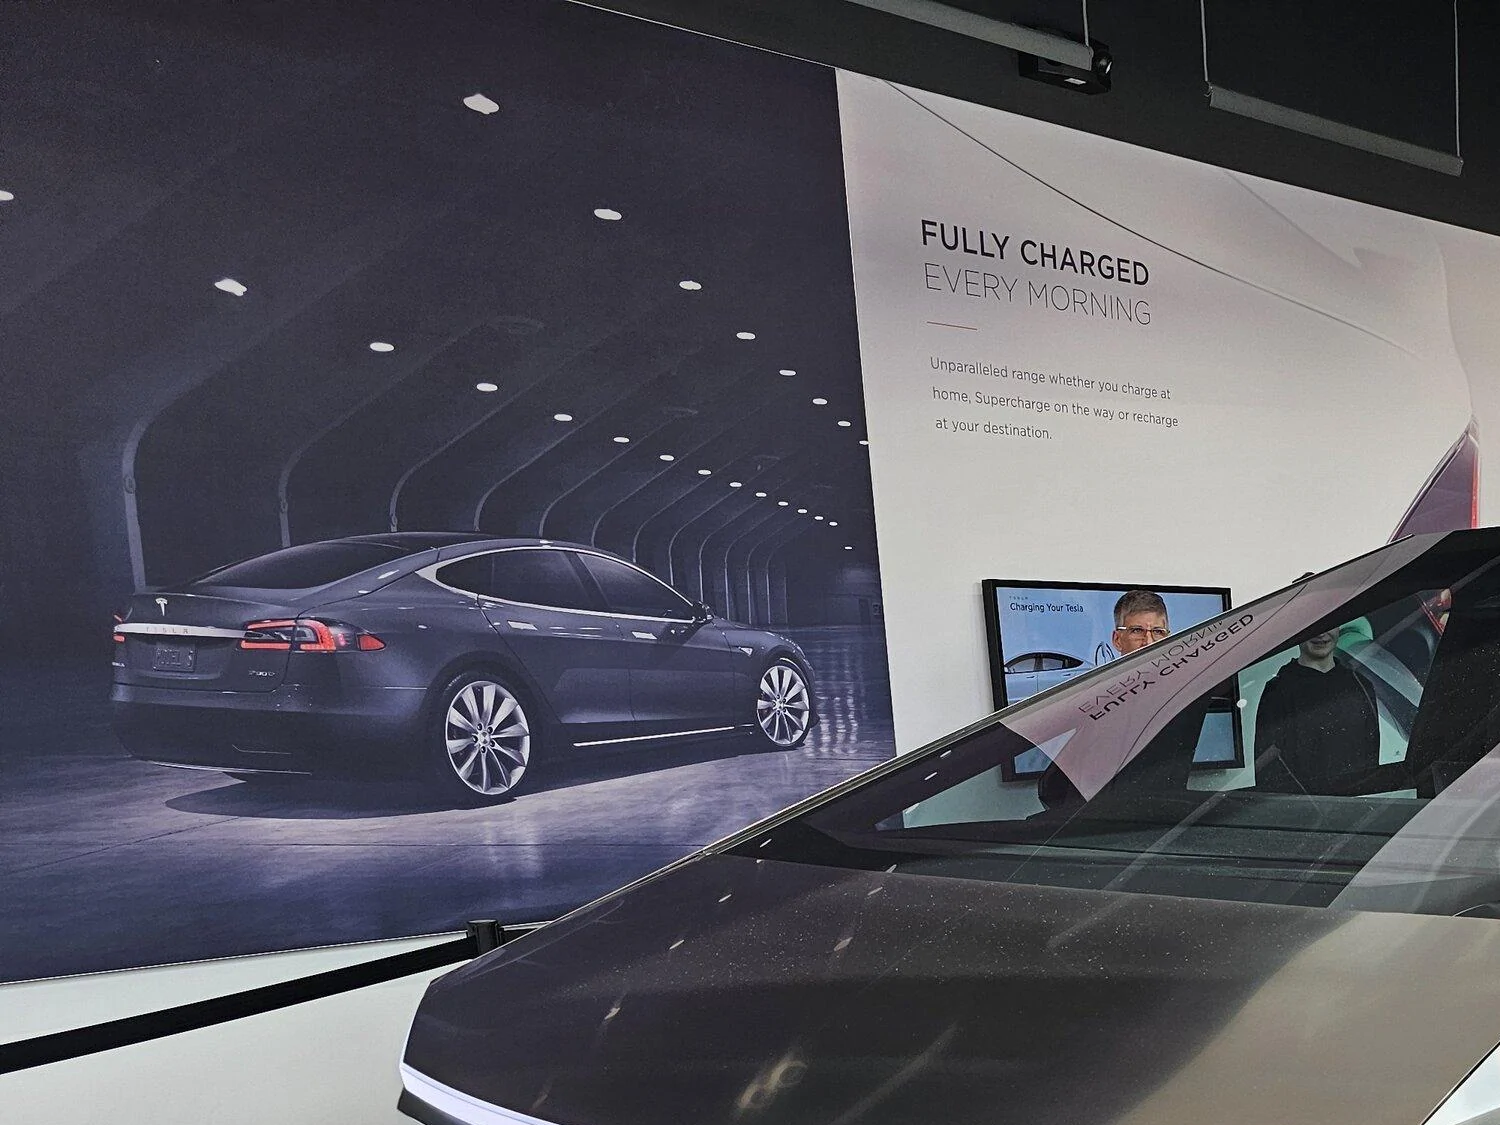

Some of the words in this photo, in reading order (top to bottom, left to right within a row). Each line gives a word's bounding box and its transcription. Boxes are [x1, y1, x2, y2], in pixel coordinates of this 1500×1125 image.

[921, 219, 1010, 260] FULLY
[1020, 239, 1150, 286] CHARGED
[924, 262, 1018, 302] EVERY
[1028, 280, 1151, 325] MORNING
[930, 356, 1008, 378] Unparalleled
[1012, 369, 1046, 384] range
[1048, 373, 1096, 389] whether
[1098, 381, 1118, 392] you
[1121, 382, 1158, 398] charge
[1160, 389, 1171, 400] at
[932, 386, 971, 404] home,
[975, 391, 1050, 412] Supercharge
[1054, 403, 1069, 413] on
[1072, 403, 1090, 416] the
[1093, 407, 1115, 420] way
[1118, 411, 1130, 420] or
[1132, 412, 1179, 428] recharge
[935, 418, 948, 430] at
[951, 420, 979, 432] your
[983, 421, 1052, 440] destination.
[1009, 602, 1045, 613] Charging
[1046, 603, 1064, 612] Your
[1065, 603, 1084, 612] Tesla
